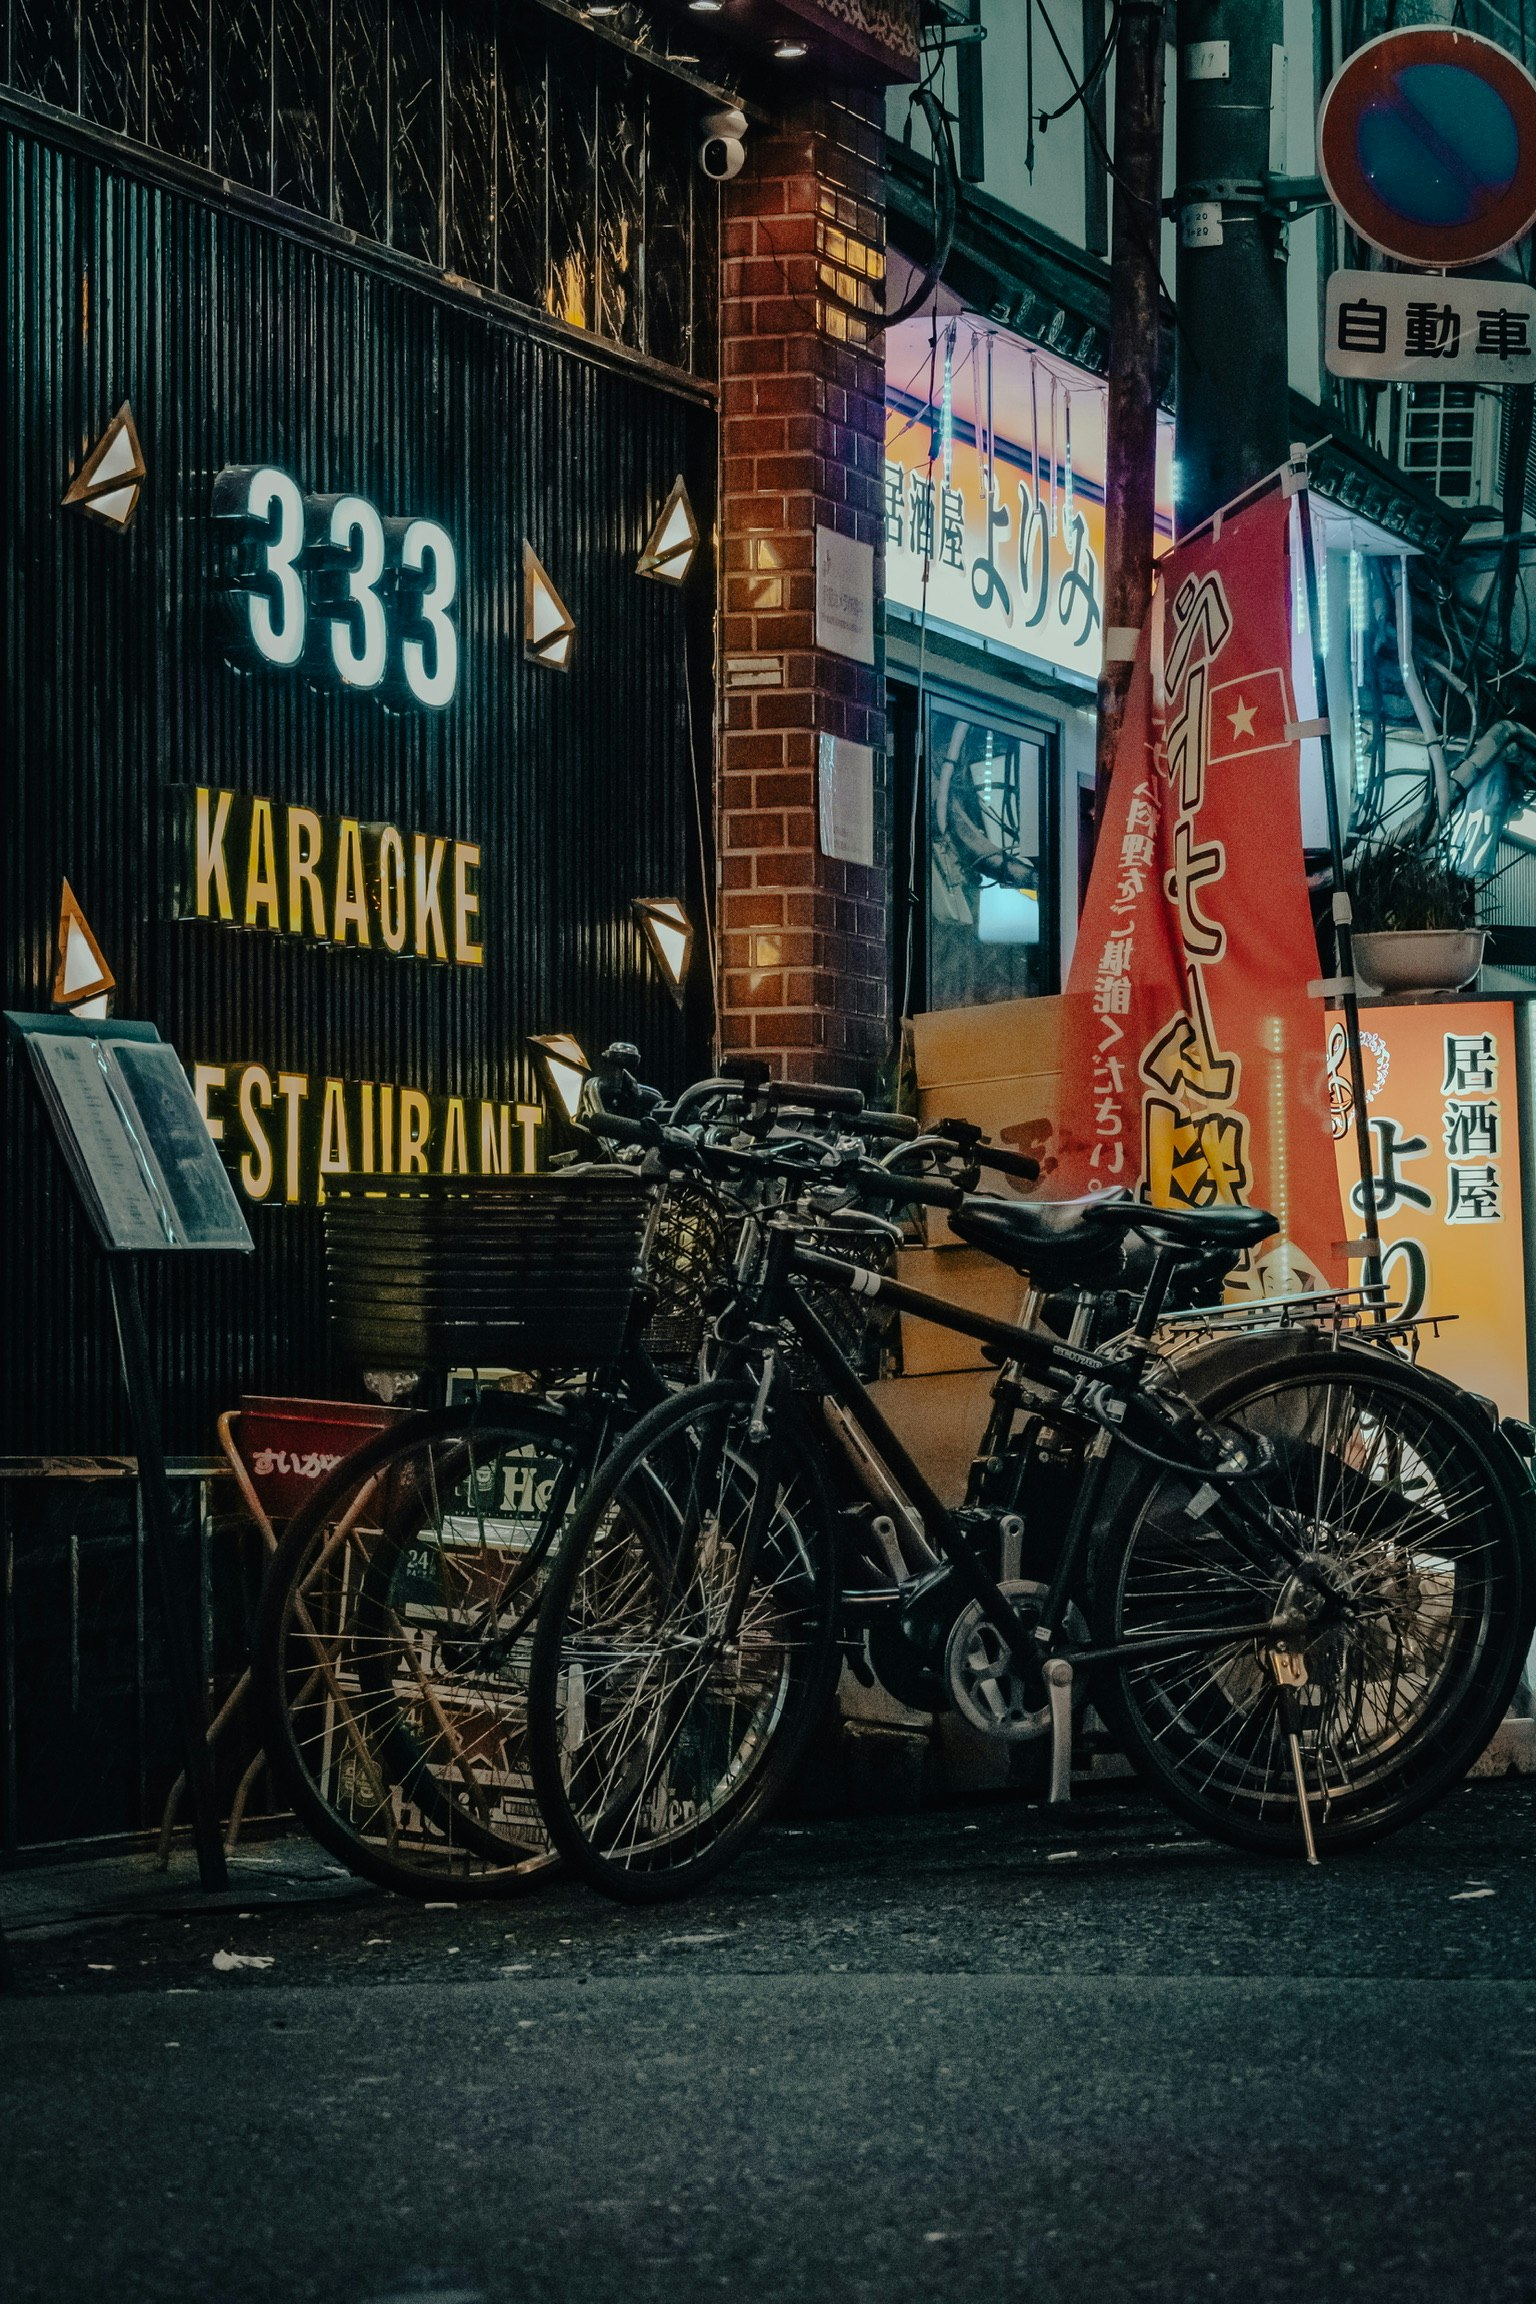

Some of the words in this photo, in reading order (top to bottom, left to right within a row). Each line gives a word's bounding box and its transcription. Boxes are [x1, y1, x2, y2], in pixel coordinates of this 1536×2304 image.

[1338, 297, 1532, 360] 自動車
[245, 466, 460, 710] 333
[196, 786, 484, 967] KARAOKE
[194, 1063, 543, 1206] ESTAURANT
[1443, 1033, 1502, 1221] 居酒屋
[1351, 1118, 1433, 1323] より
